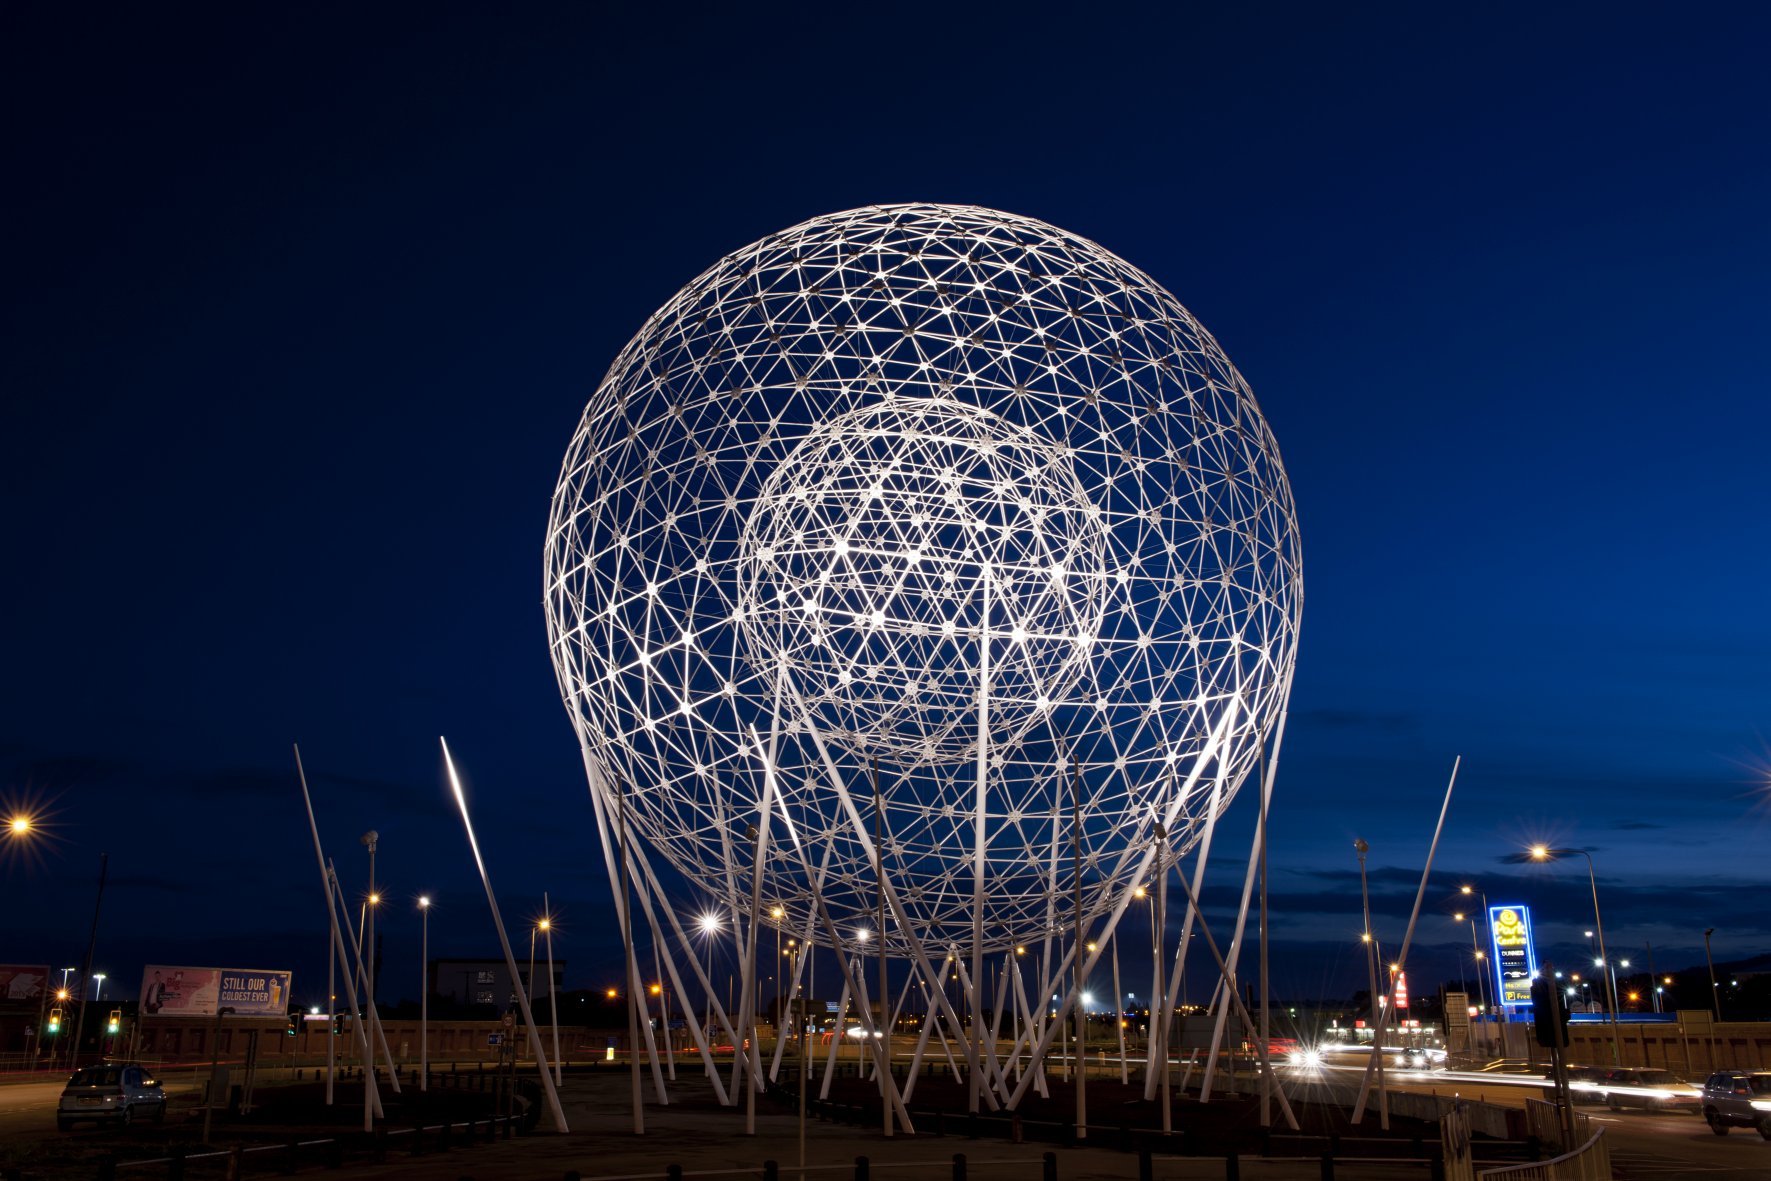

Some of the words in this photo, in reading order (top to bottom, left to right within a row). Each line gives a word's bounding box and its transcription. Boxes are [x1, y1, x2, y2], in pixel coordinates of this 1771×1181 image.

[1494, 921, 1525, 935] Park
[1497, 935, 1527, 945] Centre
[223, 977, 245, 990] STILL
[248, 978, 265, 990] OUR
[222, 991, 251, 1000] COLDEST
[252, 992, 268, 1001] EVER
[1516, 992, 1531, 1000] Free
